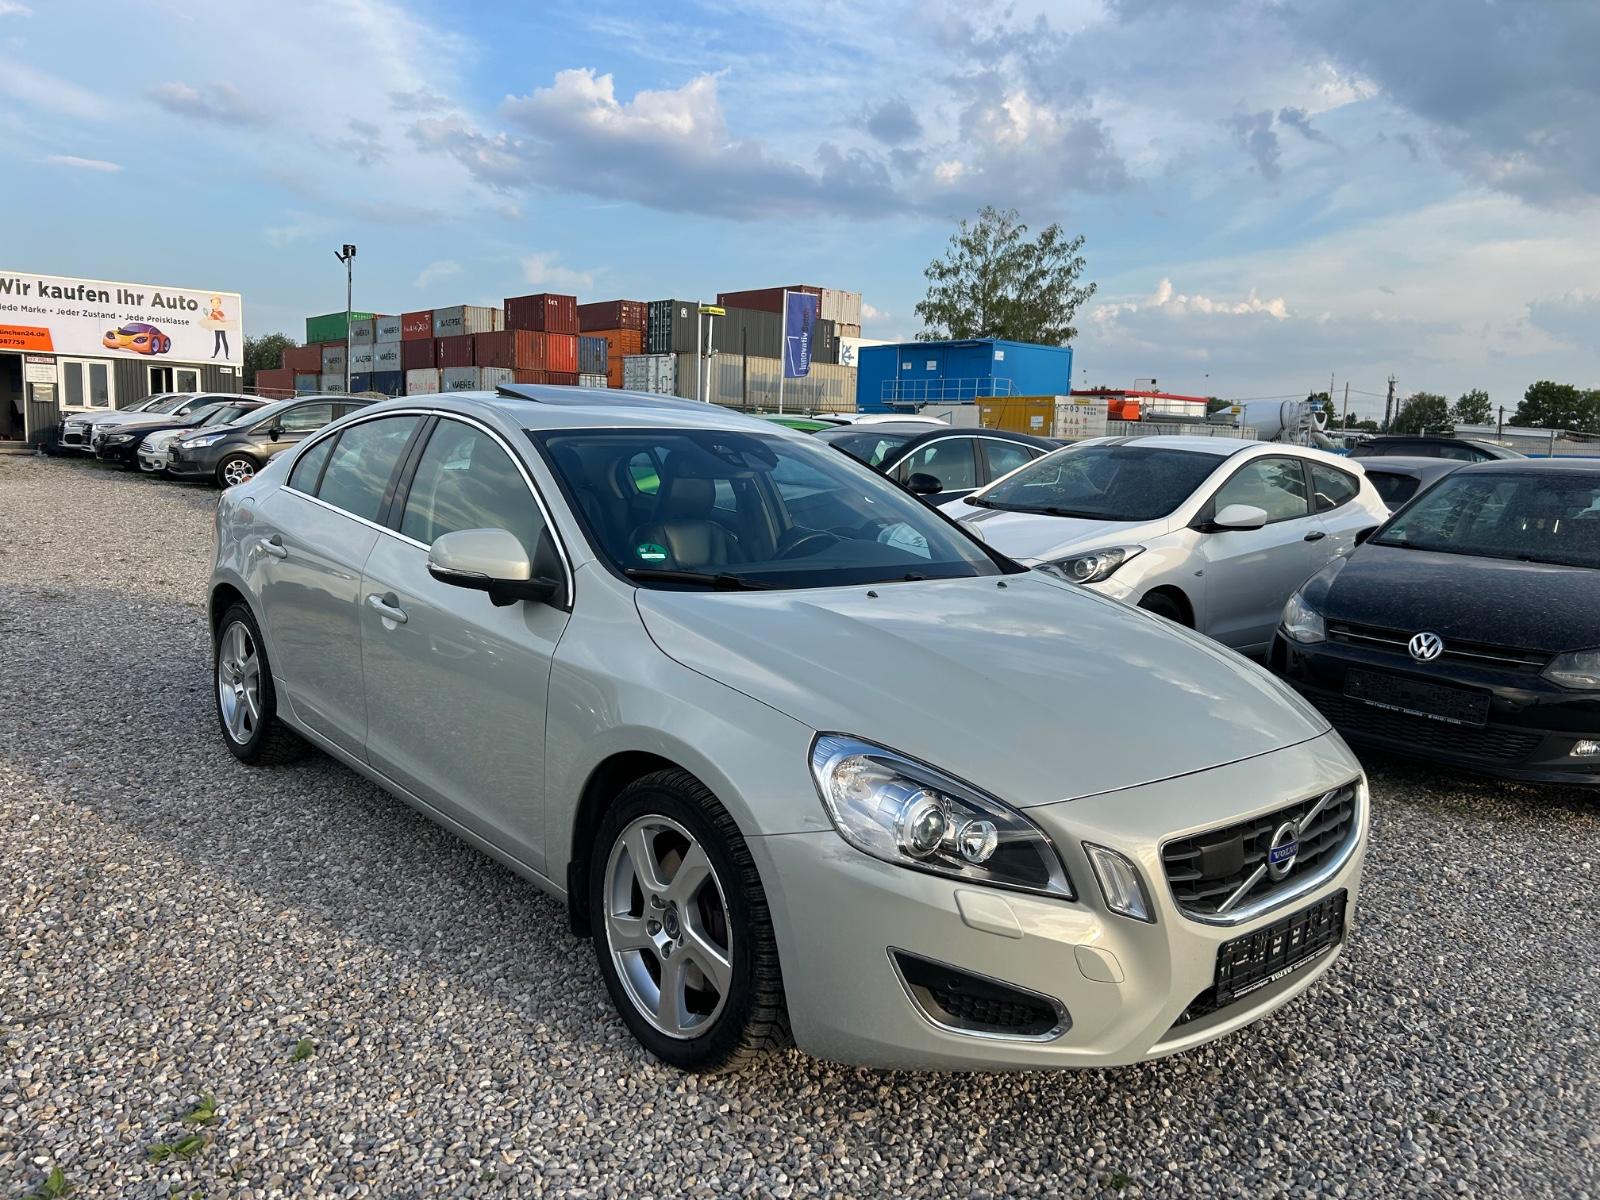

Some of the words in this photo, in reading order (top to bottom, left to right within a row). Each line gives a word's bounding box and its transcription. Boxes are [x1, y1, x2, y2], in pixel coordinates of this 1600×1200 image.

[0, 278, 30, 296] Wir
[38, 280, 110, 303] kaufen
[117, 288, 144, 306] Ihr
[151, 292, 198, 311] Auto
[21, 305, 47, 314] Marke
[56, 308, 80, 317] Jeder
[82, 309, 116, 320] Zustand
[124, 313, 144, 322] Jede
[146, 315, 190, 326] Preisklasse
